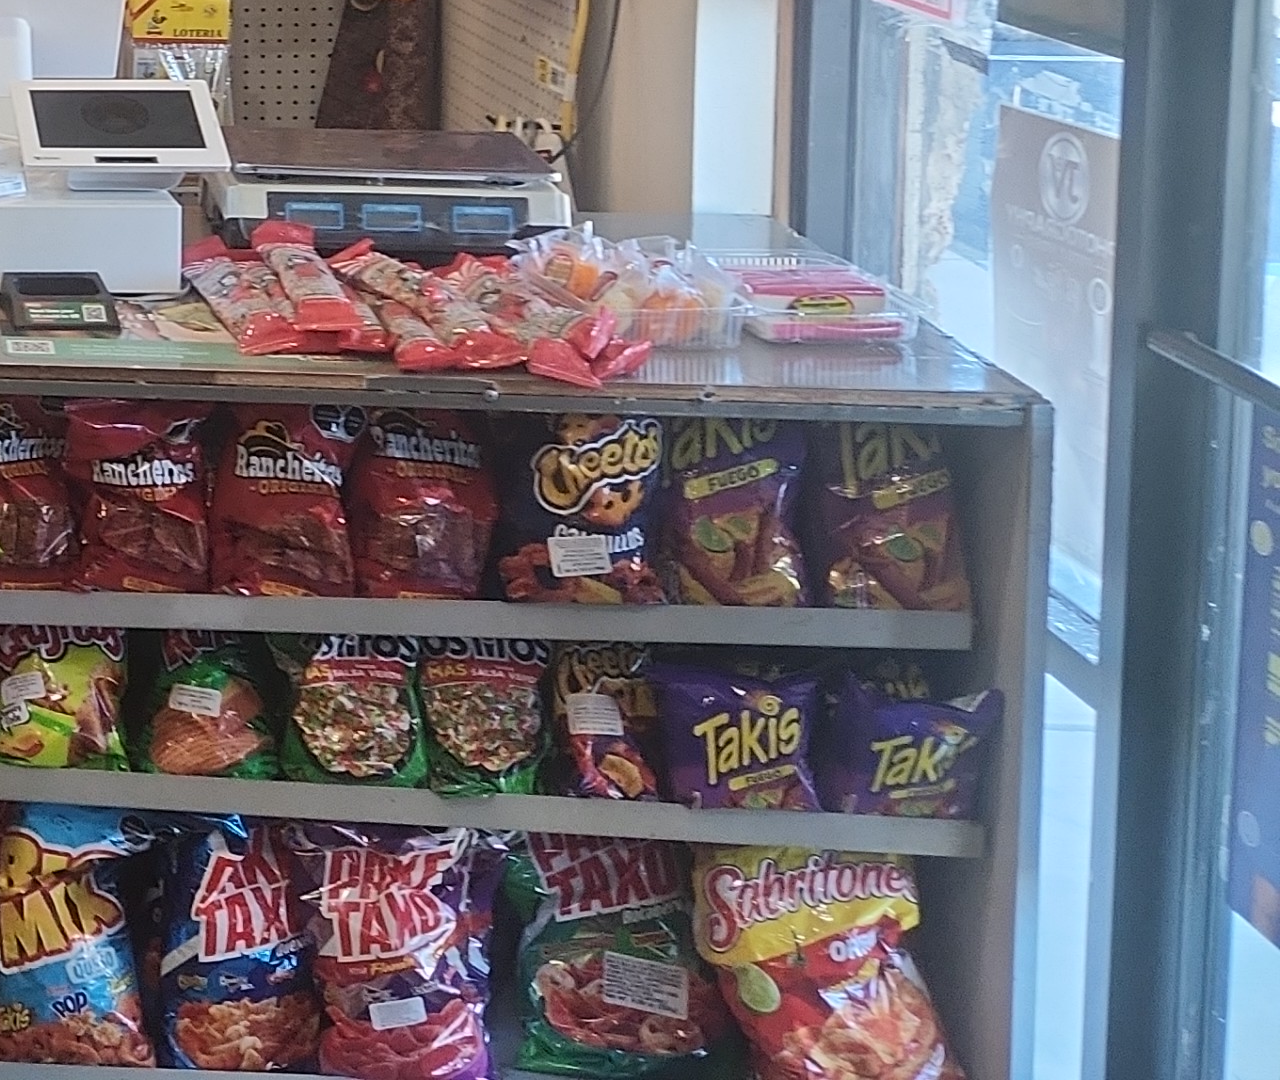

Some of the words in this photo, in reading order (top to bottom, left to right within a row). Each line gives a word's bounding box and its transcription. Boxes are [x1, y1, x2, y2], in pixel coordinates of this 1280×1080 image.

[173, 28, 223, 38] LOTERIA
[707, 466, 760, 492] FUEGO
[313, 634, 417, 667] STITOS
[693, 696, 802, 786] Takis
[871, 730, 960, 793] Tak
[199, 882, 296, 956] TAX
[53, 991, 88, 1017] POP
